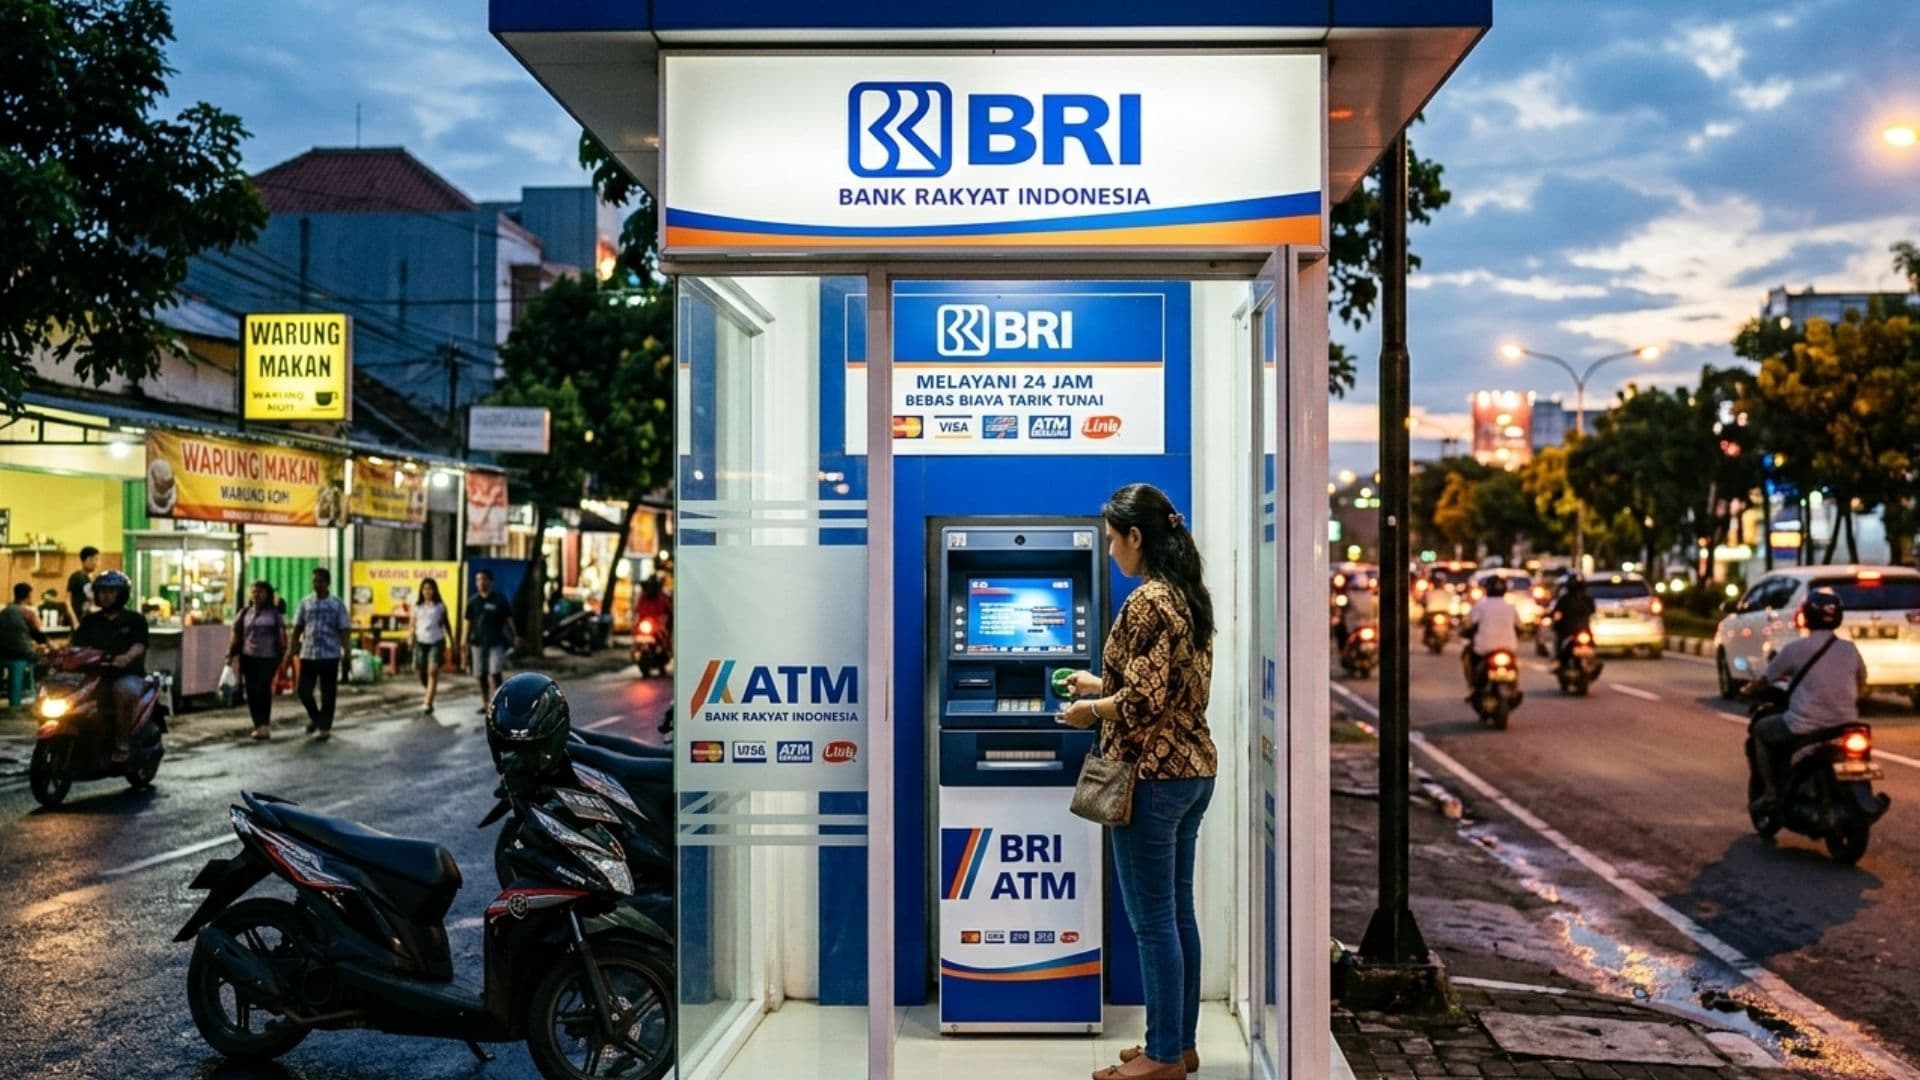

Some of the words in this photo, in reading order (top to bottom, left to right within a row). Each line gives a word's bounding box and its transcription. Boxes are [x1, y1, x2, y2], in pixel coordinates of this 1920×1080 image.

[968, 93, 1142, 166] BRI
[839, 187, 906, 206] BANK
[915, 187, 1010, 206] RAKYAT
[1018, 187, 1151, 206] INDONESIA
[250, 321, 340, 346] WARUNG
[995, 310, 1073, 350] BRI
[259, 354, 331, 378] MAKAN
[916, 374, 1017, 390] MELAYANI
[1023, 374, 1047, 390] 24
[1052, 374, 1093, 390] JAM
[905, 394, 954, 407] BEBAS
[959, 394, 1004, 407] BIAYA
[1009, 394, 1053, 407] TARIK
[1058, 394, 1104, 407] TUNAI
[938, 421, 969, 433] VISA
[1031, 416, 1068, 431] ATM
[181, 440, 260, 480] WARUNG
[264, 454, 320, 485] MAKAN
[740, 665, 859, 704] ATM
[705, 711, 739, 722] BANK
[743, 711, 790, 722] RAKYAT
[792, 711, 859, 722] INDONESIA
[1000, 834, 1062, 863] BRI
[990, 872, 1076, 900] ATM
